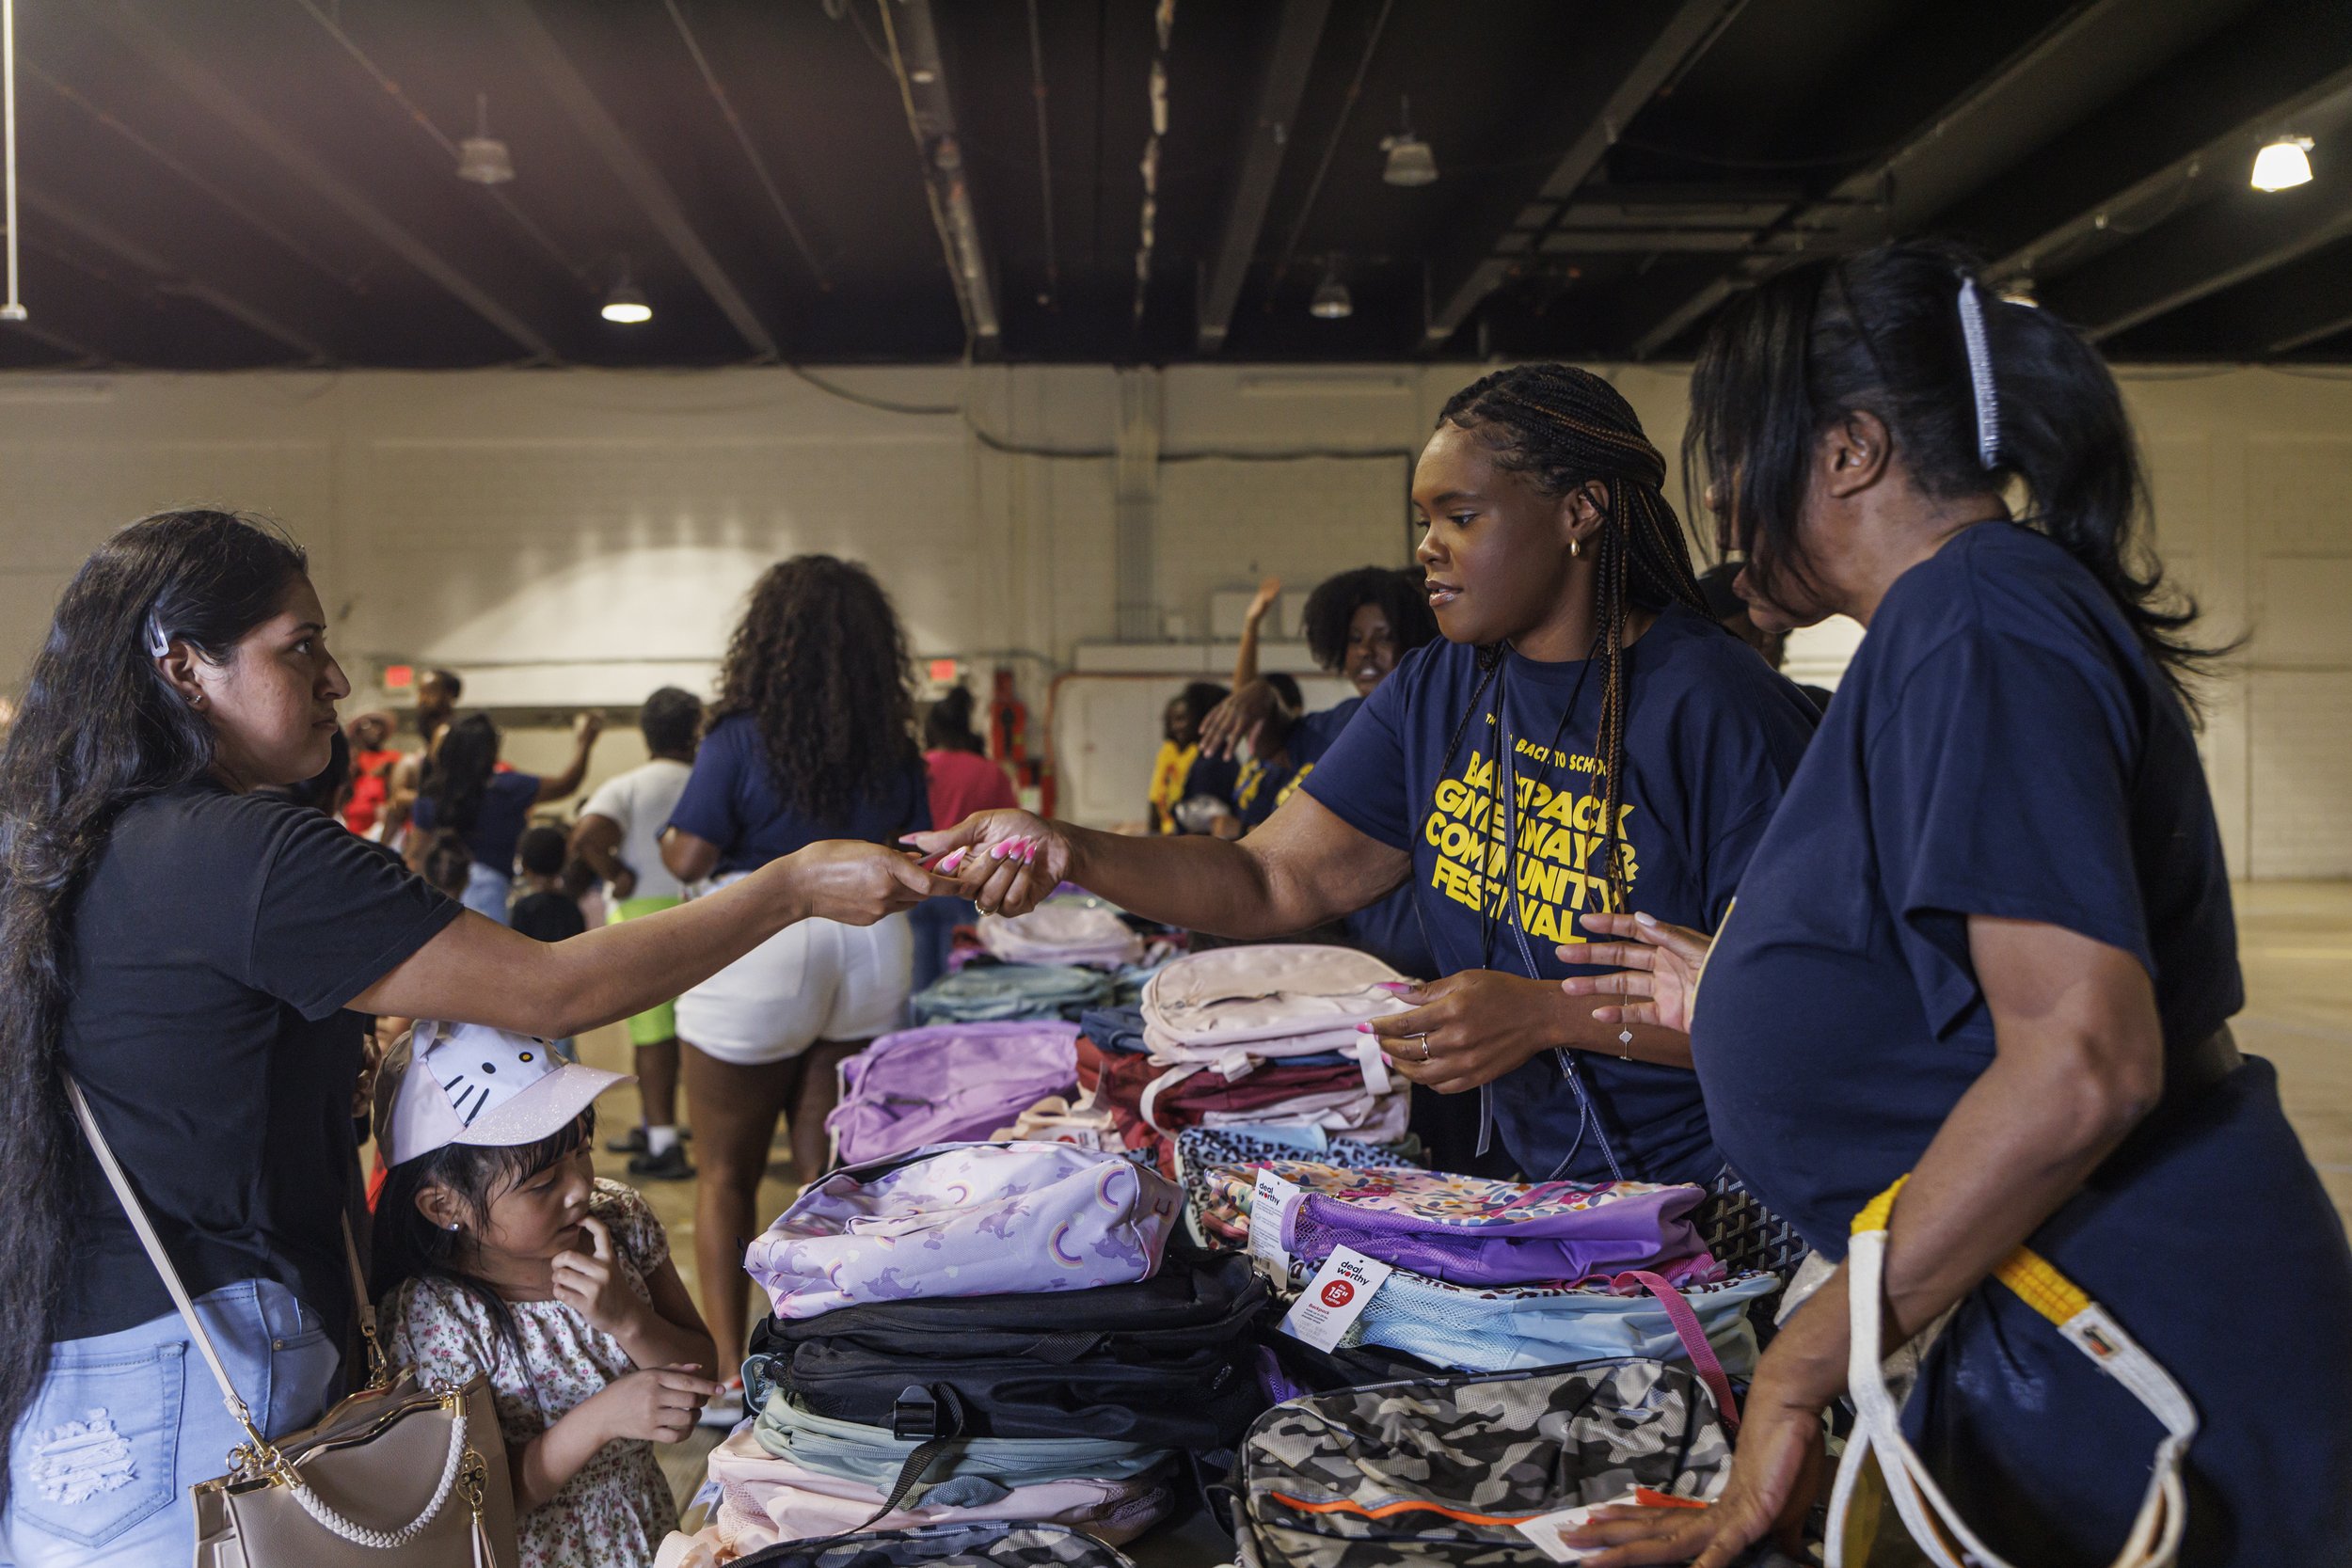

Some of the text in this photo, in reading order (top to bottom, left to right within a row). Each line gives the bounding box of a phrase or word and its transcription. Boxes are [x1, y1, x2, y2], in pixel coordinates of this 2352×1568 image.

[1554, 751, 1566, 768] TO
[1569, 754, 1607, 776] SCHO
[1463, 751, 1635, 840] BAPACK
[1431, 854, 1587, 944] FESTVAL
[1258, 1190, 1280, 1206] worthy
[1259, 1182, 1274, 1195] deal
[1337, 1267, 1370, 1286] worthy
[1341, 1260, 1363, 1275] deal
